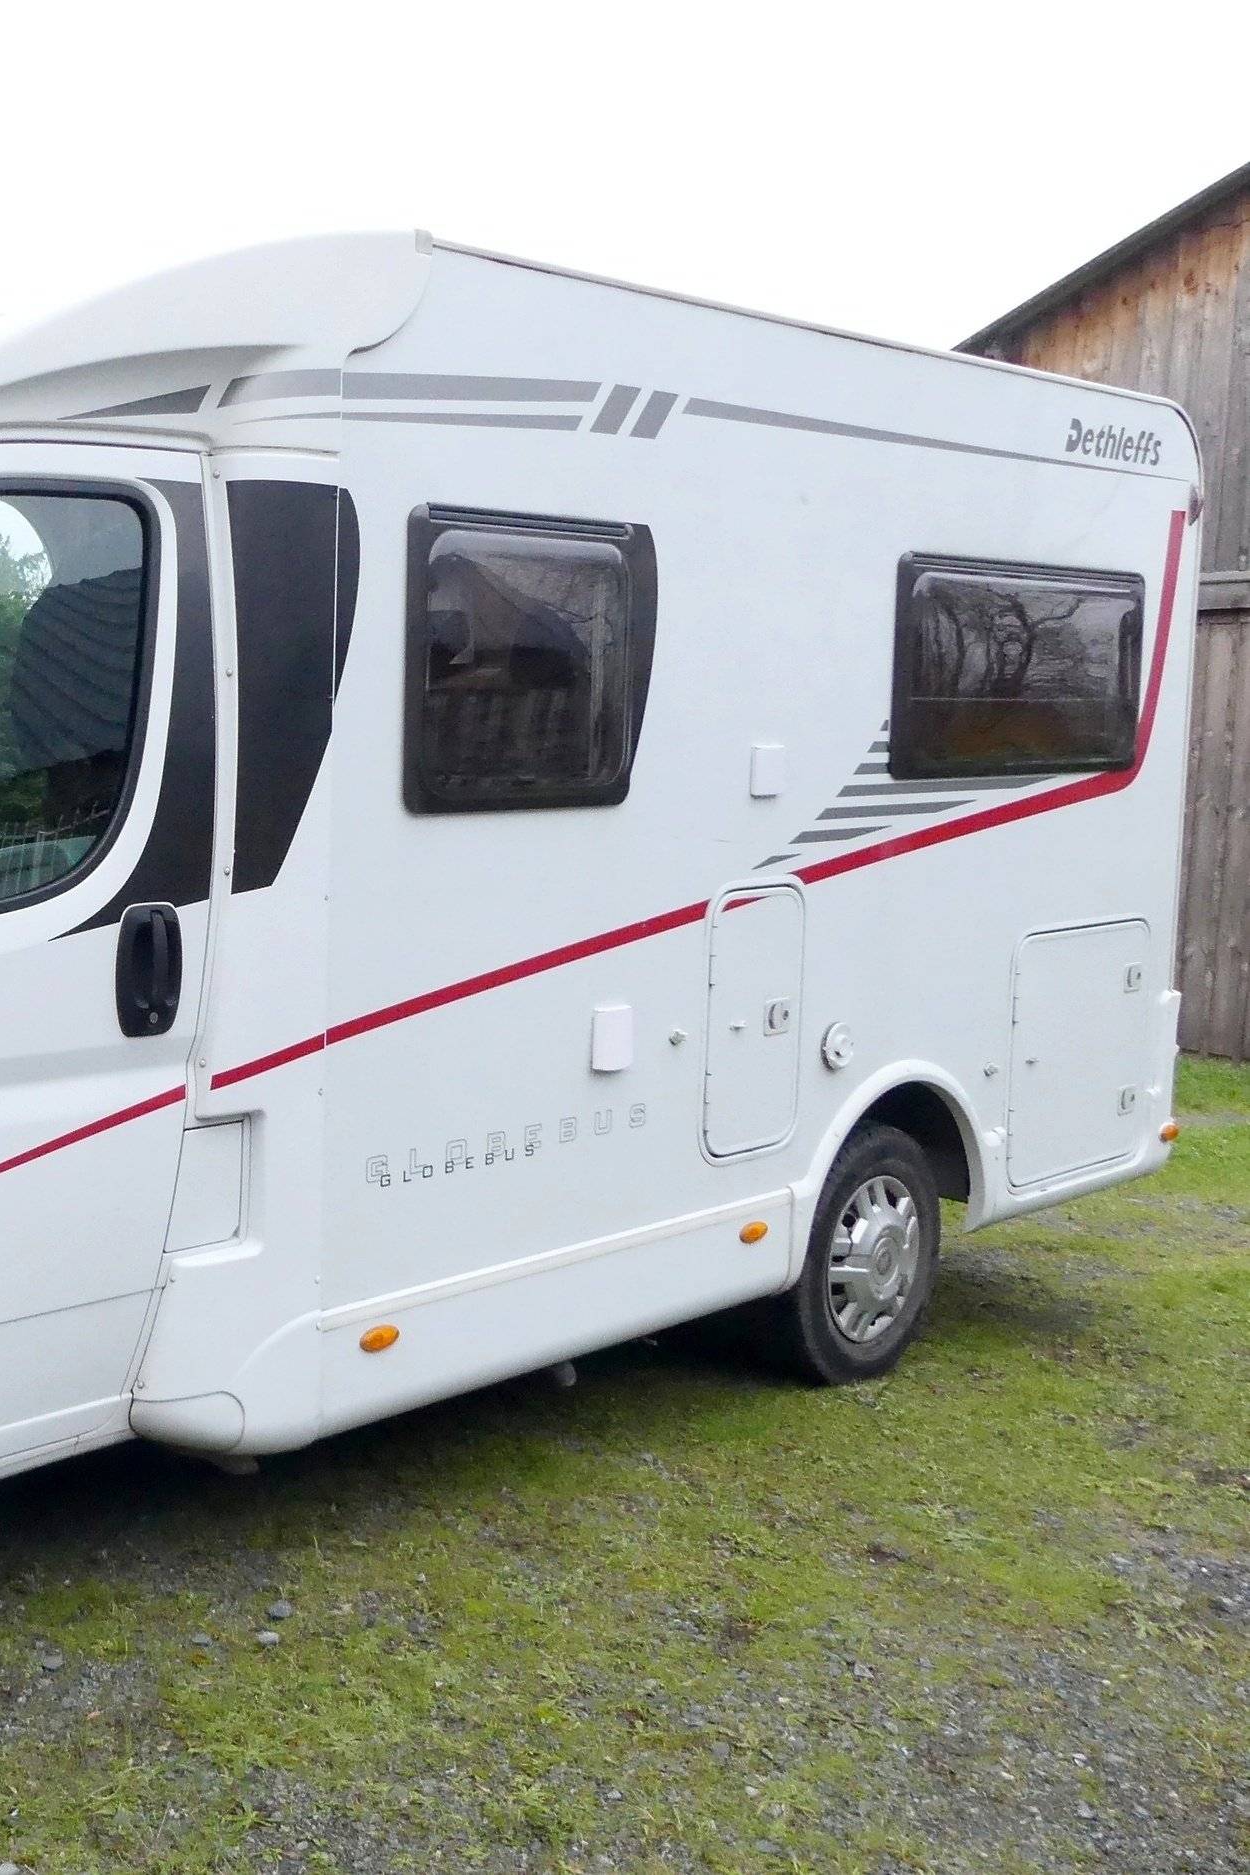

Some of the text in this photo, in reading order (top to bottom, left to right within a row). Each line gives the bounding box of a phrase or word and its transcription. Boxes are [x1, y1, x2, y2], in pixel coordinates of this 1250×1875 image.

[1065, 418, 1162, 466] Dethleffs
[365, 1103, 647, 1184] GLOBEBUS
[380, 1144, 535, 1187] GLOBEBUS
